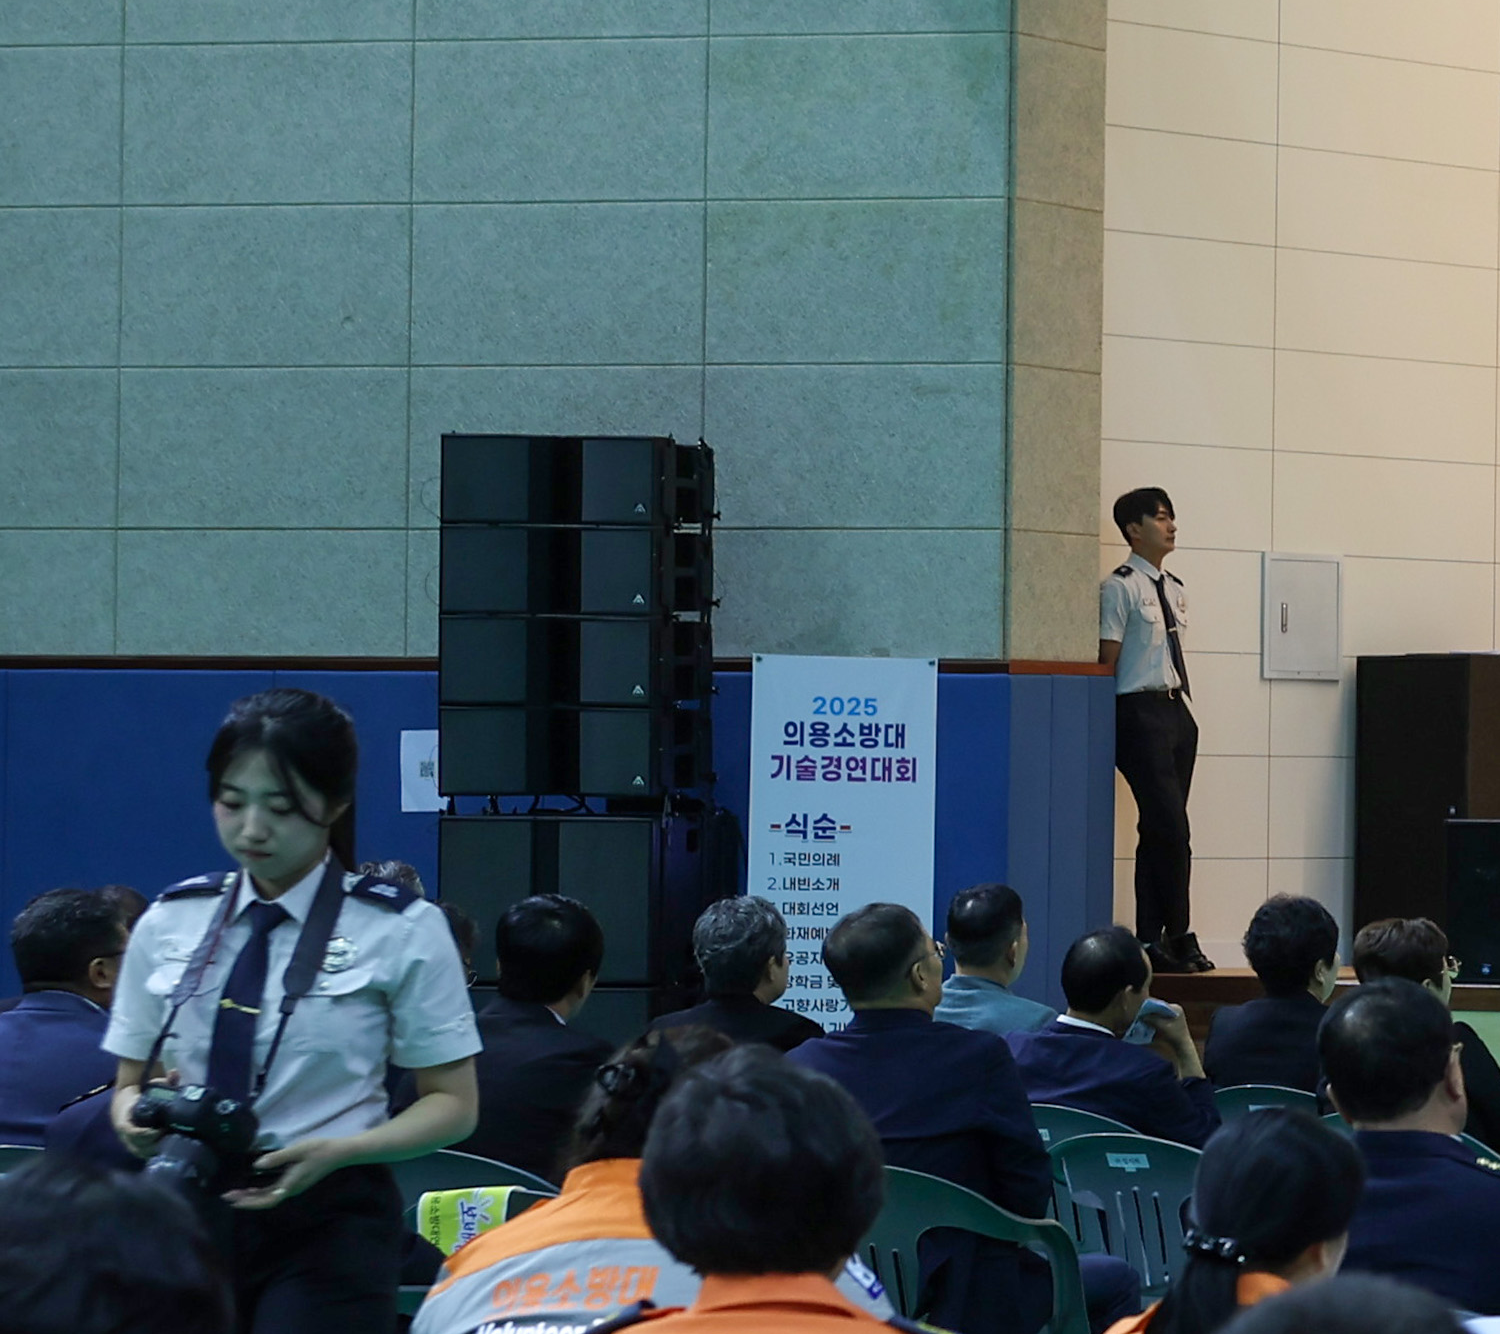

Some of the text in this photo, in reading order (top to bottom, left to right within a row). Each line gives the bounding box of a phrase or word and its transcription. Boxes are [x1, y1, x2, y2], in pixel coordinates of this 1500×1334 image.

[812, 696, 878, 716] 2025
[783, 721, 906, 749] 의용소방대
[770, 754, 917, 783] 기술경연대회
